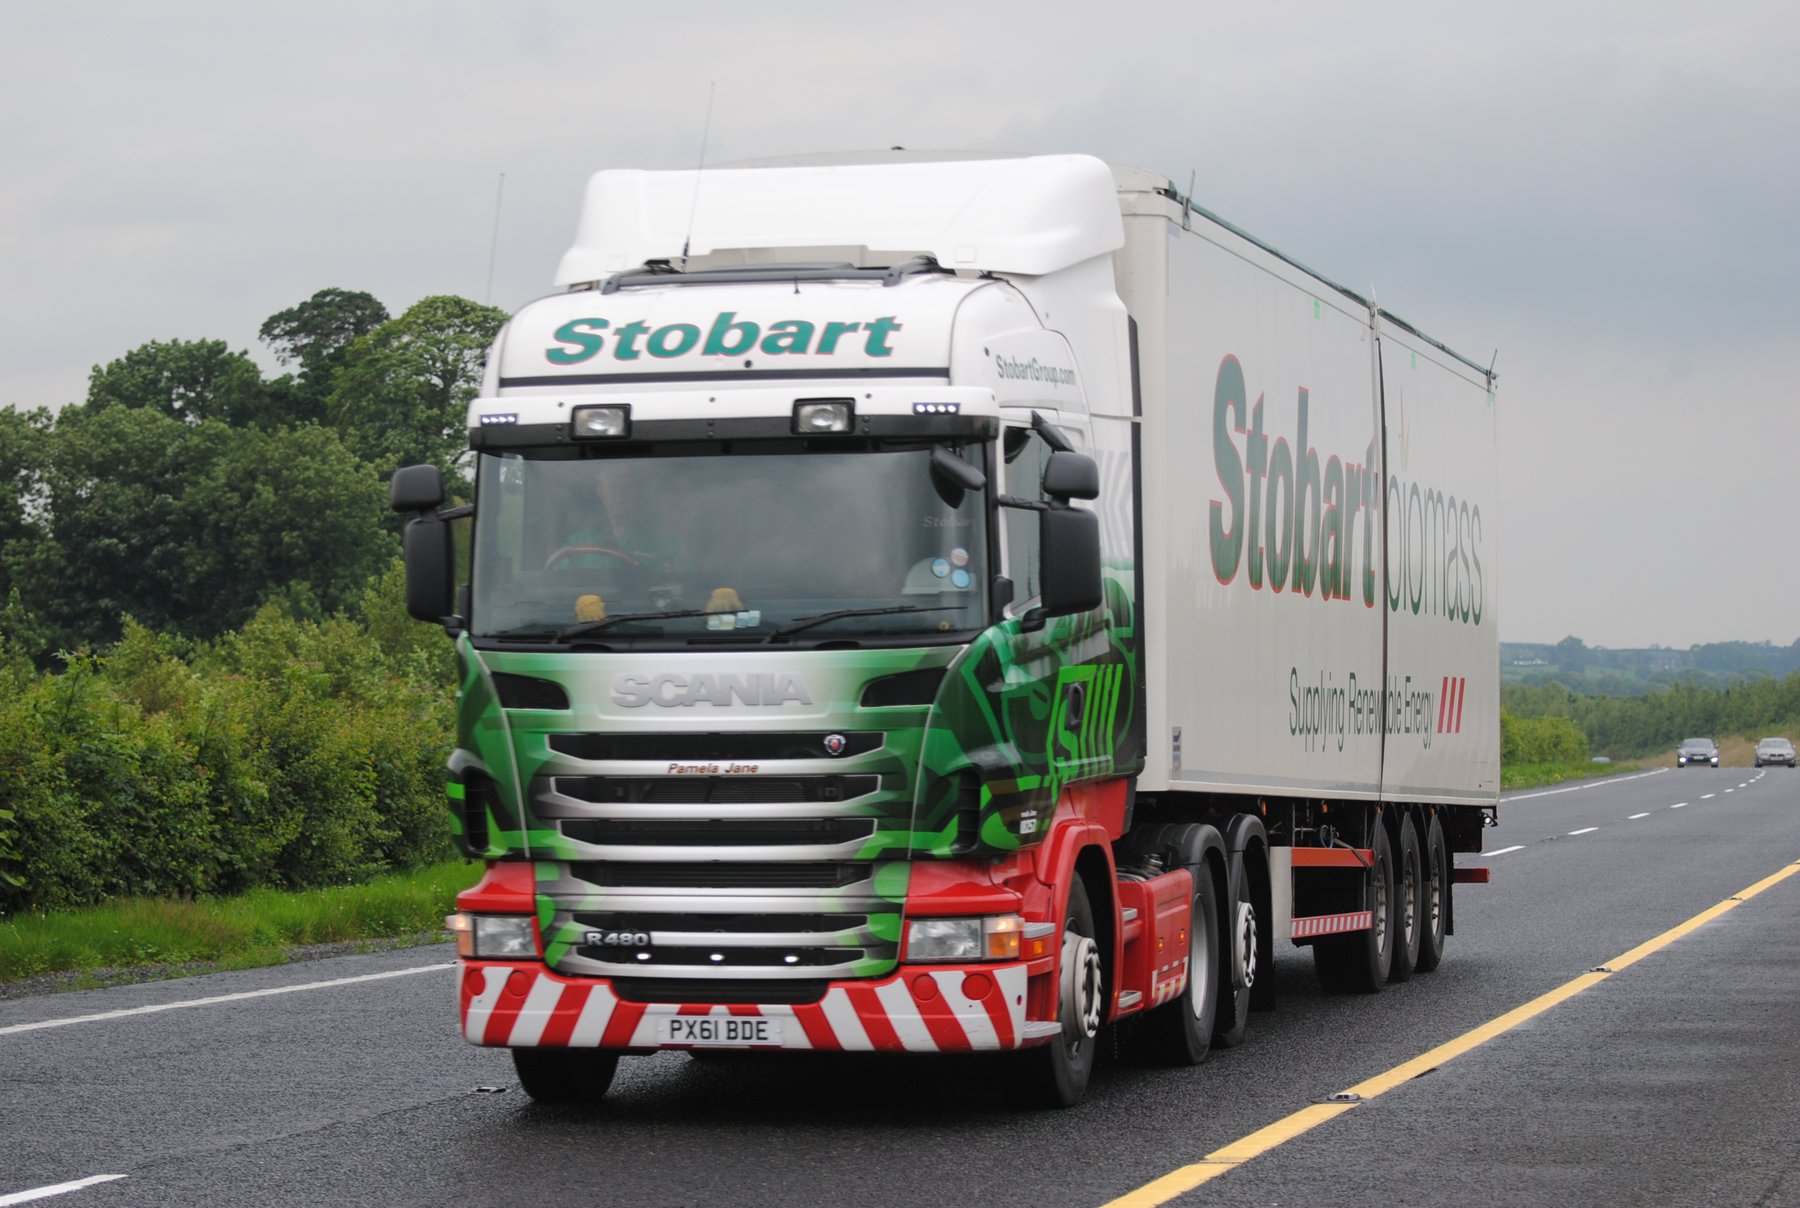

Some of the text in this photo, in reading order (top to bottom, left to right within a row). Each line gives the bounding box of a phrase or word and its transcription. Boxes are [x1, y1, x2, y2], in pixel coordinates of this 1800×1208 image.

[545, 311, 903, 366] Stobart
[996, 354, 1076, 389] StobartGroup.com
[1208, 353, 1378, 609] Stobart
[611, 671, 813, 708] SCANIA
[1289, 666, 1435, 752] Supplying Renewble Energy
[667, 763, 759, 774] Pamela Jane
[670, 1020, 769, 1040] PX61 BDE
